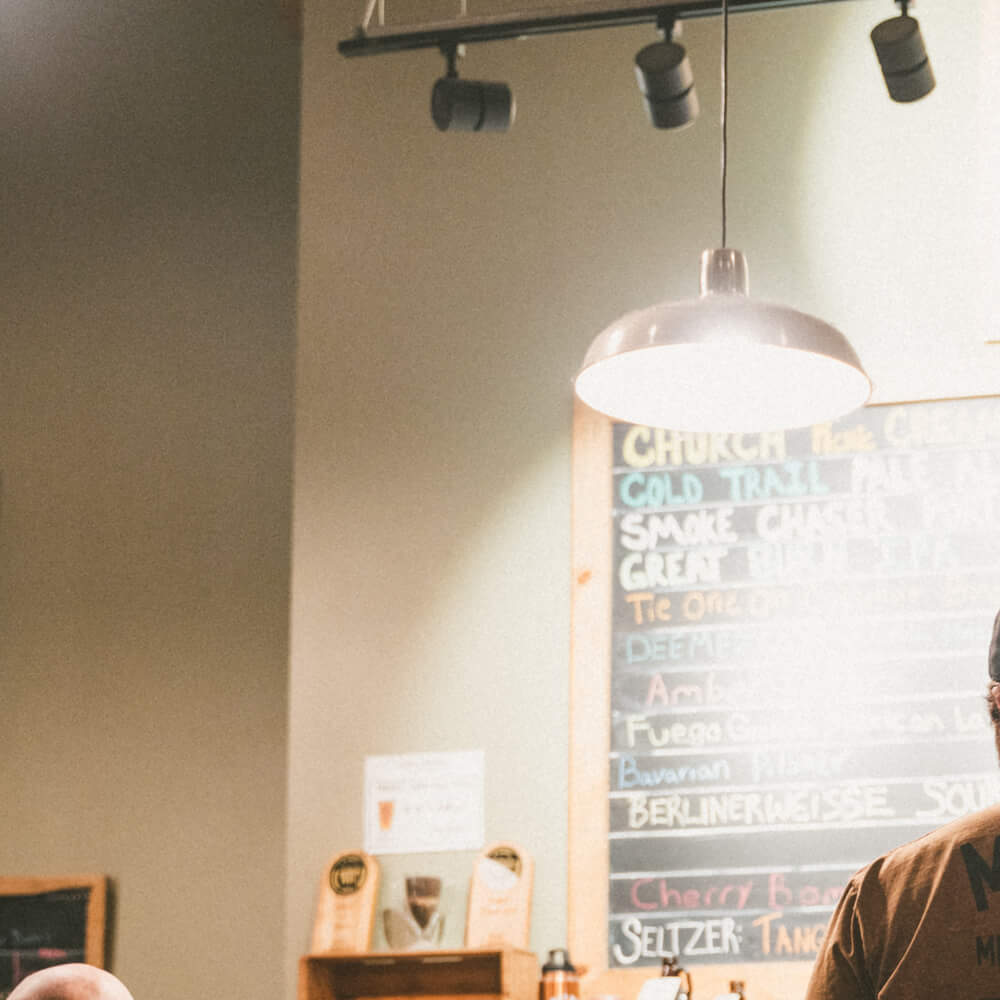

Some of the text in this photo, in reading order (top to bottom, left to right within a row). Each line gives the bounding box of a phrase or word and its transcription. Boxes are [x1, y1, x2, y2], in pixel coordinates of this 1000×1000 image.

[622, 424, 787, 468] CHURCH
[719, 461, 830, 500] TRAIL
[619, 509, 739, 552] SMOKE
[618, 548, 730, 592] GREAT
[625, 592, 672, 625] Tie
[682, 590, 741, 620] One
[625, 714, 722, 750] Fuego
[617, 754, 731, 790] Bavarian
[629, 877, 753, 910] Cherry
